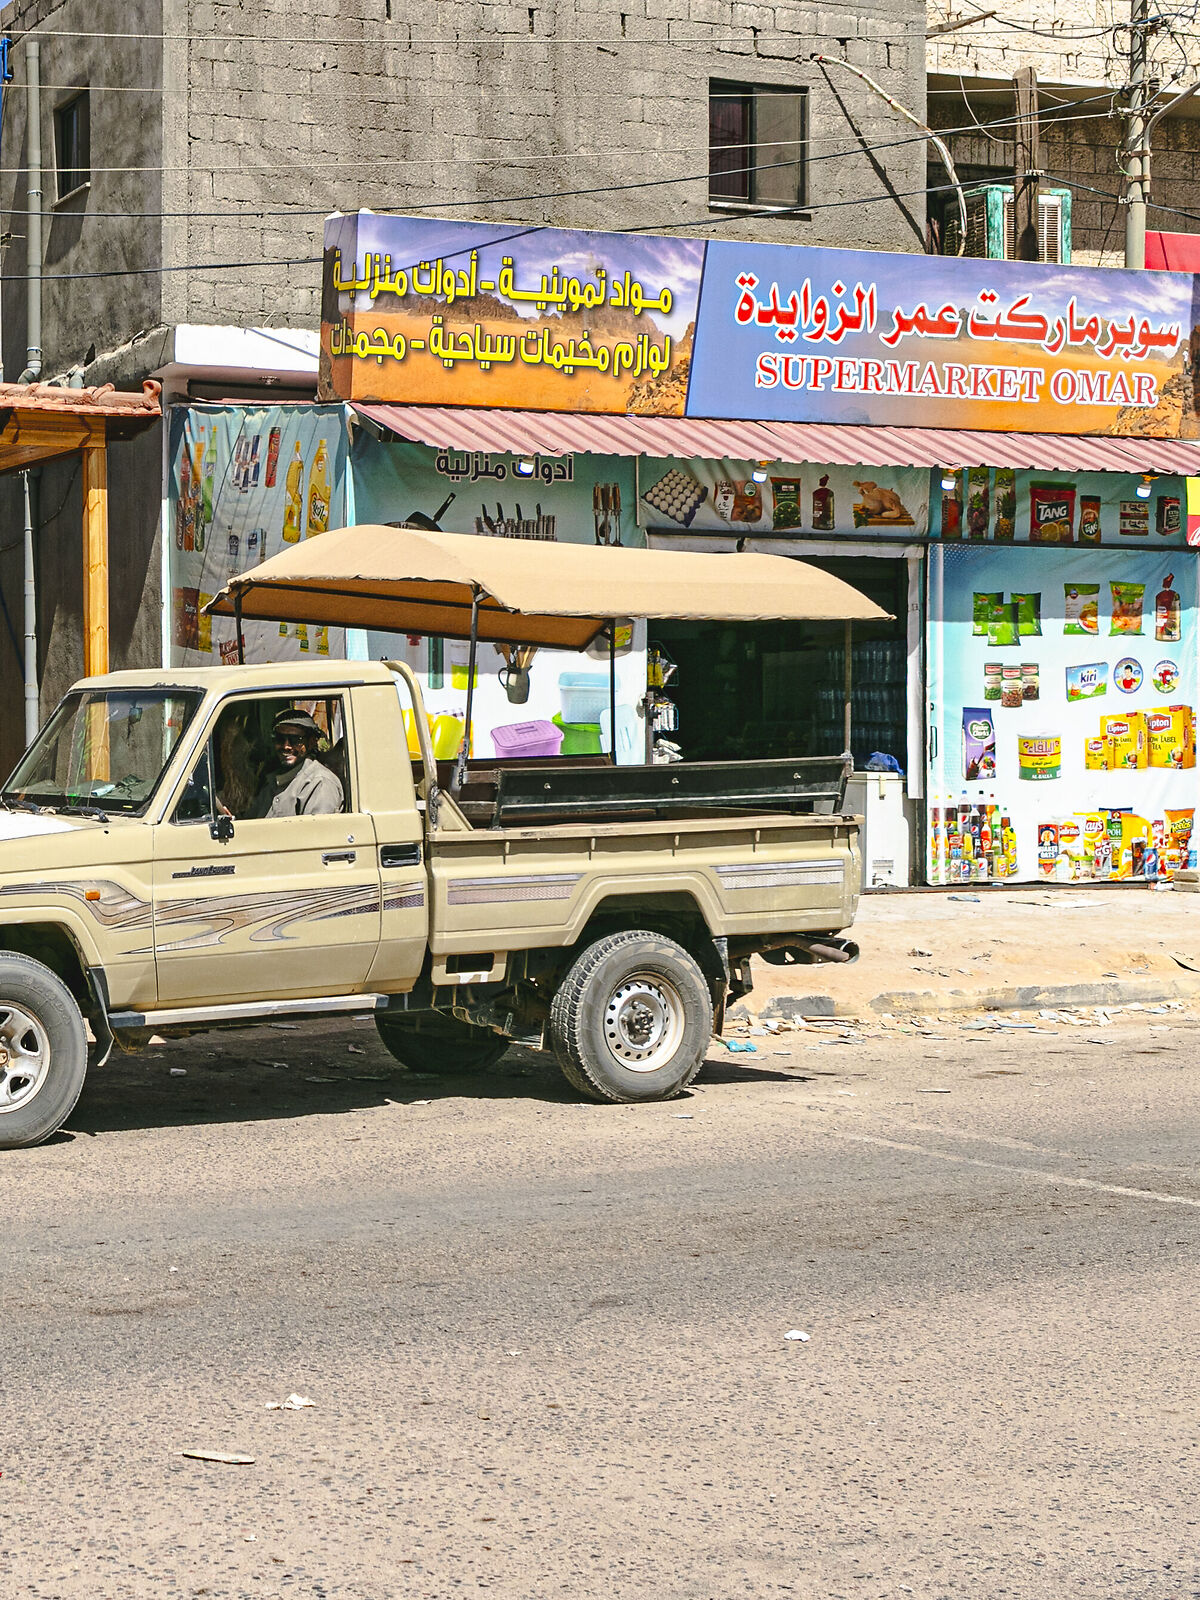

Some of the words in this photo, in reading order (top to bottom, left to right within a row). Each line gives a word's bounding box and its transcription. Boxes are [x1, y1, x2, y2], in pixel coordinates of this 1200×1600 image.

[332, 249, 408, 299] منزلية
[412, 249, 477, 303] أدوات
[499, 255, 607, 312] تموينية
[609, 270, 673, 316] مواد
[734, 272, 876, 345] الزوايدة
[881, 301, 961, 347] عمر
[967, 289, 1182, 360] سوبرماركت
[330, 319, 406, 364] مجمدات
[429, 315, 516, 370] سياحية
[520, 327, 610, 375] مخيمات
[613, 335, 671, 378] لوازم
[756, 352, 1044, 402] SUPERMARKET
[1050, 371, 1158, 406] OMAR
[1038, 504, 1068, 521] TANG
[1080, 669, 1097, 684] kiri
